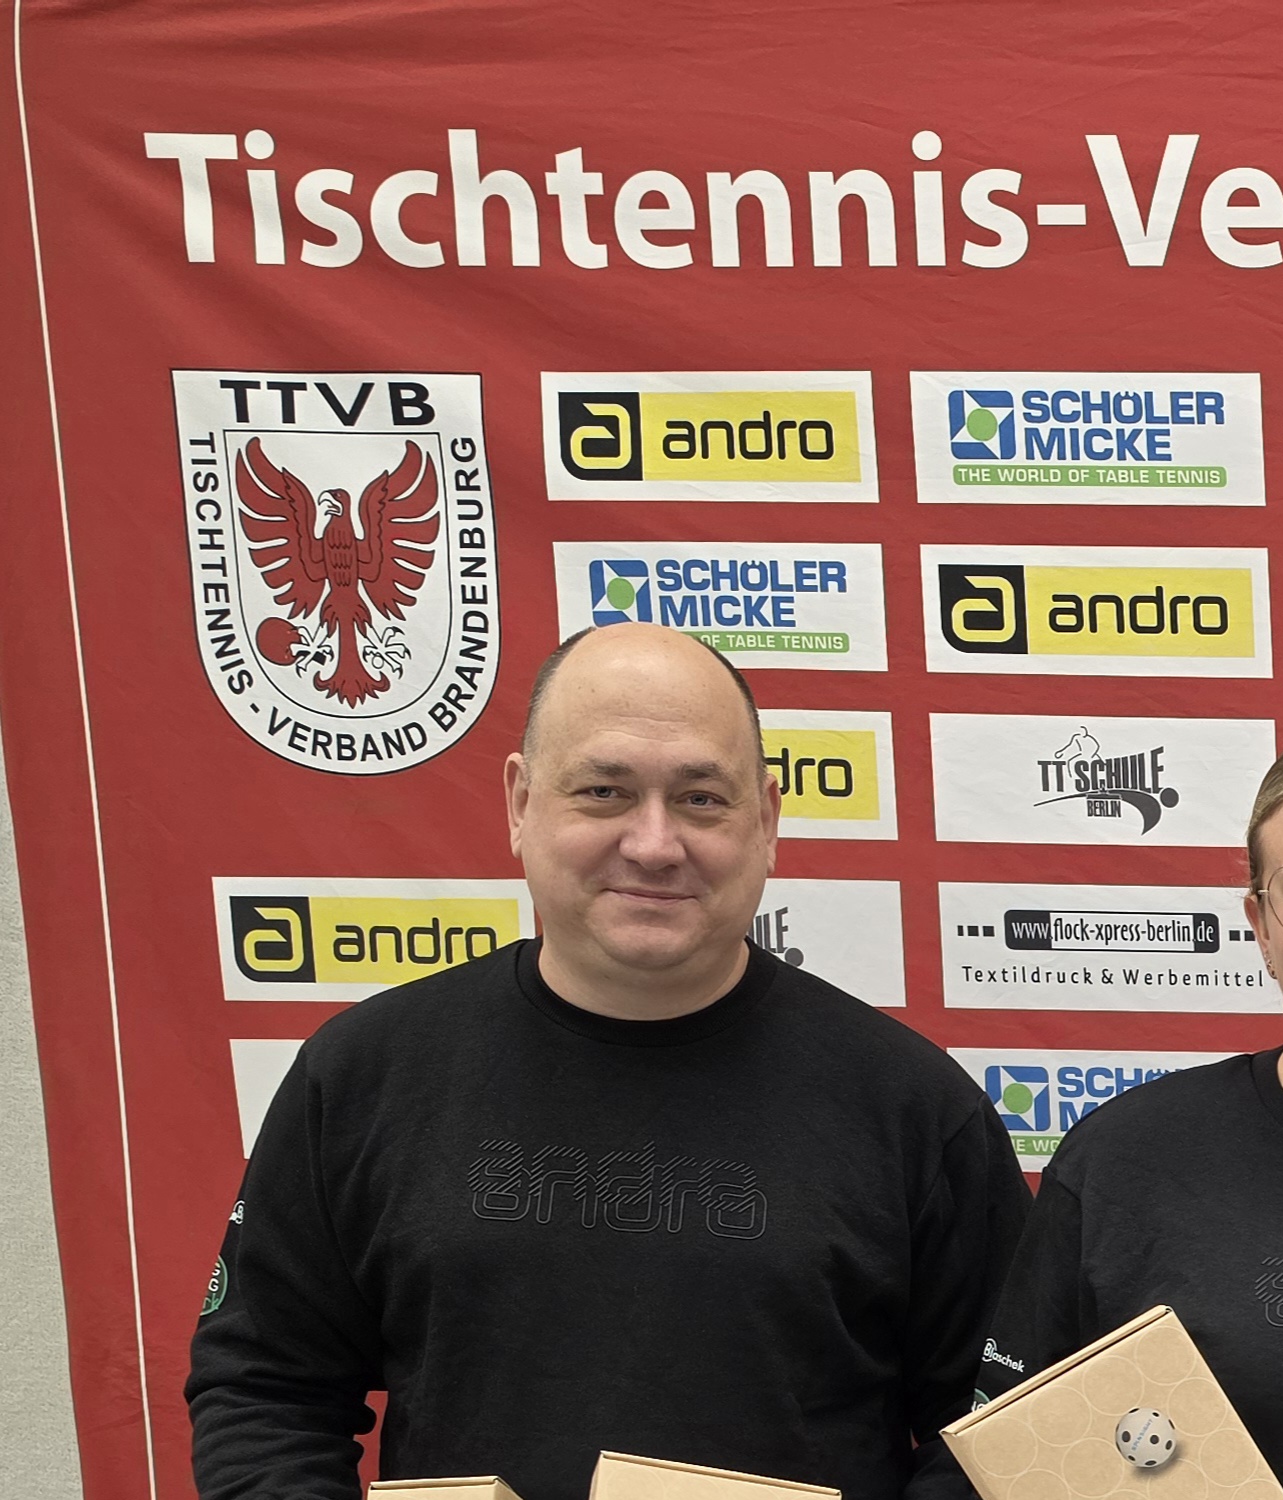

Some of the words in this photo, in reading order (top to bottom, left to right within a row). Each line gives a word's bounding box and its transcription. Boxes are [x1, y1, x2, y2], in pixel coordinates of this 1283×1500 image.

[220, 380, 436, 427] TTVB
[1022, 389, 1225, 426] SCHÖLER
[661, 411, 836, 461] andro
[1024, 428, 1172, 462] MICKE
[958, 468, 992, 482] THE
[998, 469, 1061, 483] WORLD
[1068, 469, 1091, 484] OF
[1096, 469, 1151, 484] TABLE
[1157, 470, 1221, 485] TENNIS
[655, 559, 847, 594] SCHÖLER
[189, 432, 255, 696] TISCHTENNIS
[266, 711, 429, 763] VERBAND
[429, 435, 491, 731] BRANDENBURG
[659, 595, 797, 628] MICKE
[1048, 586, 1229, 635] andro
[722, 634, 774, 649] TABLE
[779, 635, 844, 651] TENNIS
[1086, 799, 1121, 818] BERLIN
[331, 915, 499, 964] andro
[1011, 917, 1214, 946] www.flock-xpress-berlin.de
[961, 965, 1093, 986] Textildruck
[1101, 968, 1114, 985] &
[1123, 967, 1264, 988] Werbemittel
[983, 1342, 1025, 1372] Blaschek
